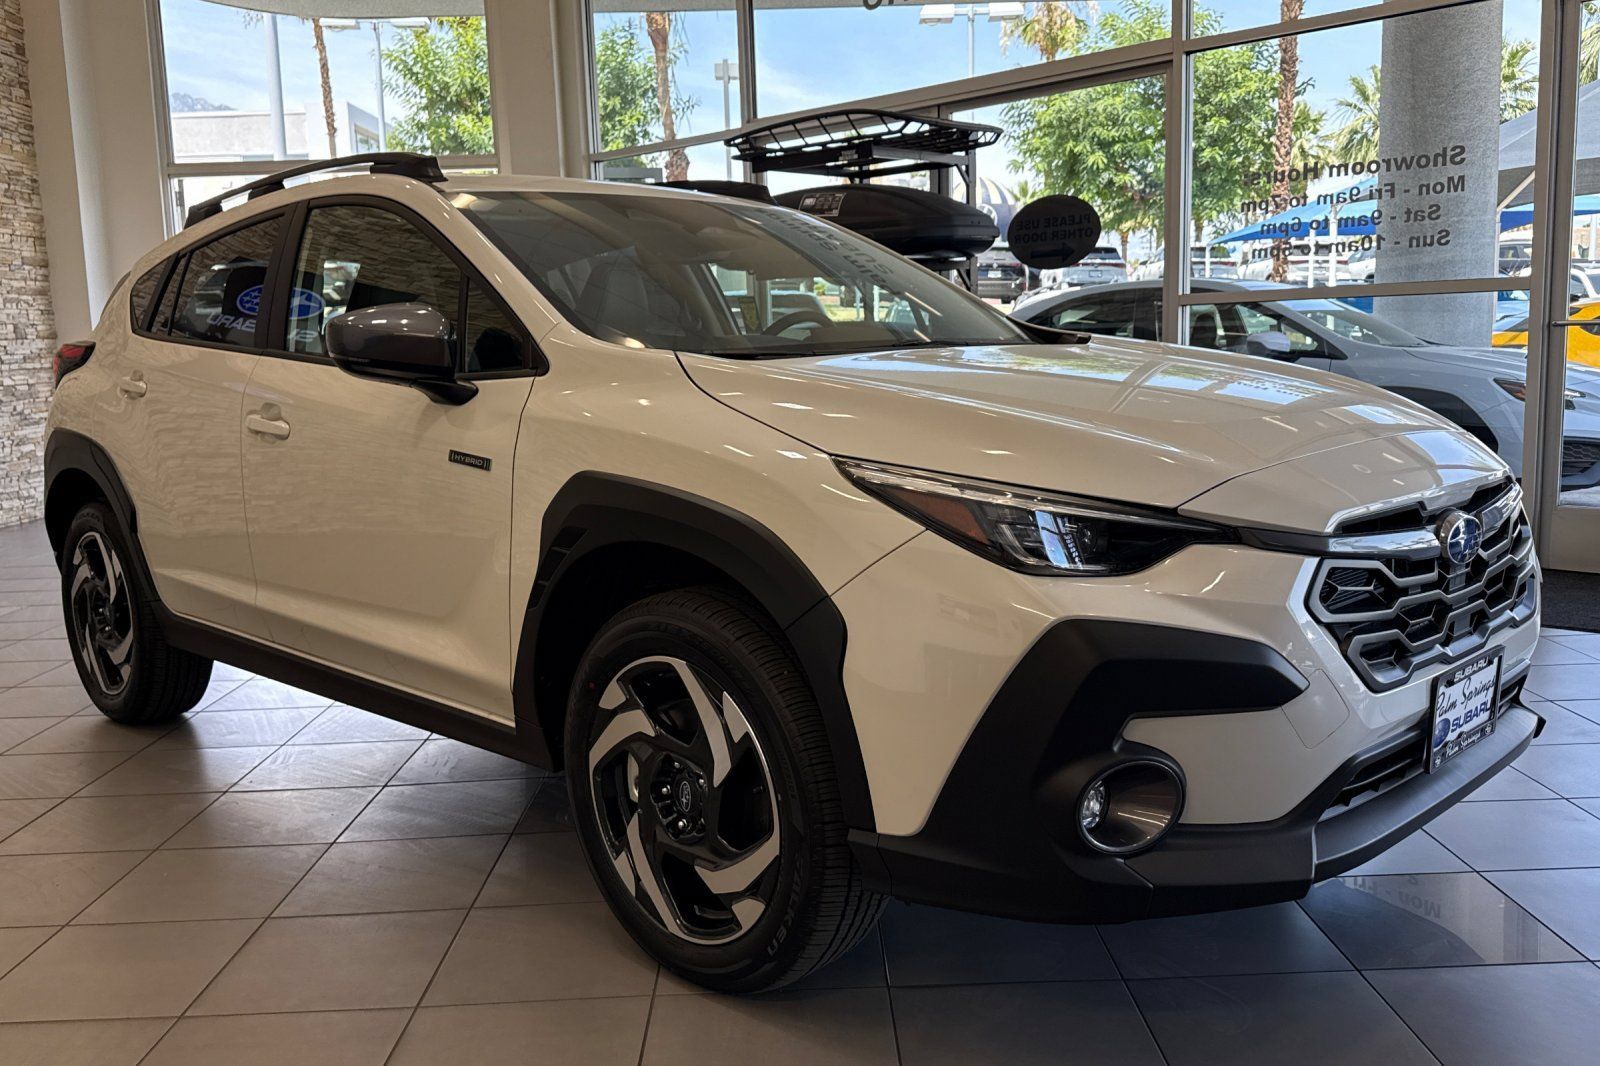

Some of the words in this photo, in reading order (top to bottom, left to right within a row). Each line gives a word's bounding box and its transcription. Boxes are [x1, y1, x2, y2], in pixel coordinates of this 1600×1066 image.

[454, 453, 484, 466] HYBRID
[1453, 656, 1489, 681] SUBARU
[1436, 691, 1458, 718] Palm
[1460, 675, 1496, 710] Springs
[1450, 699, 1491, 733] SUBARU
